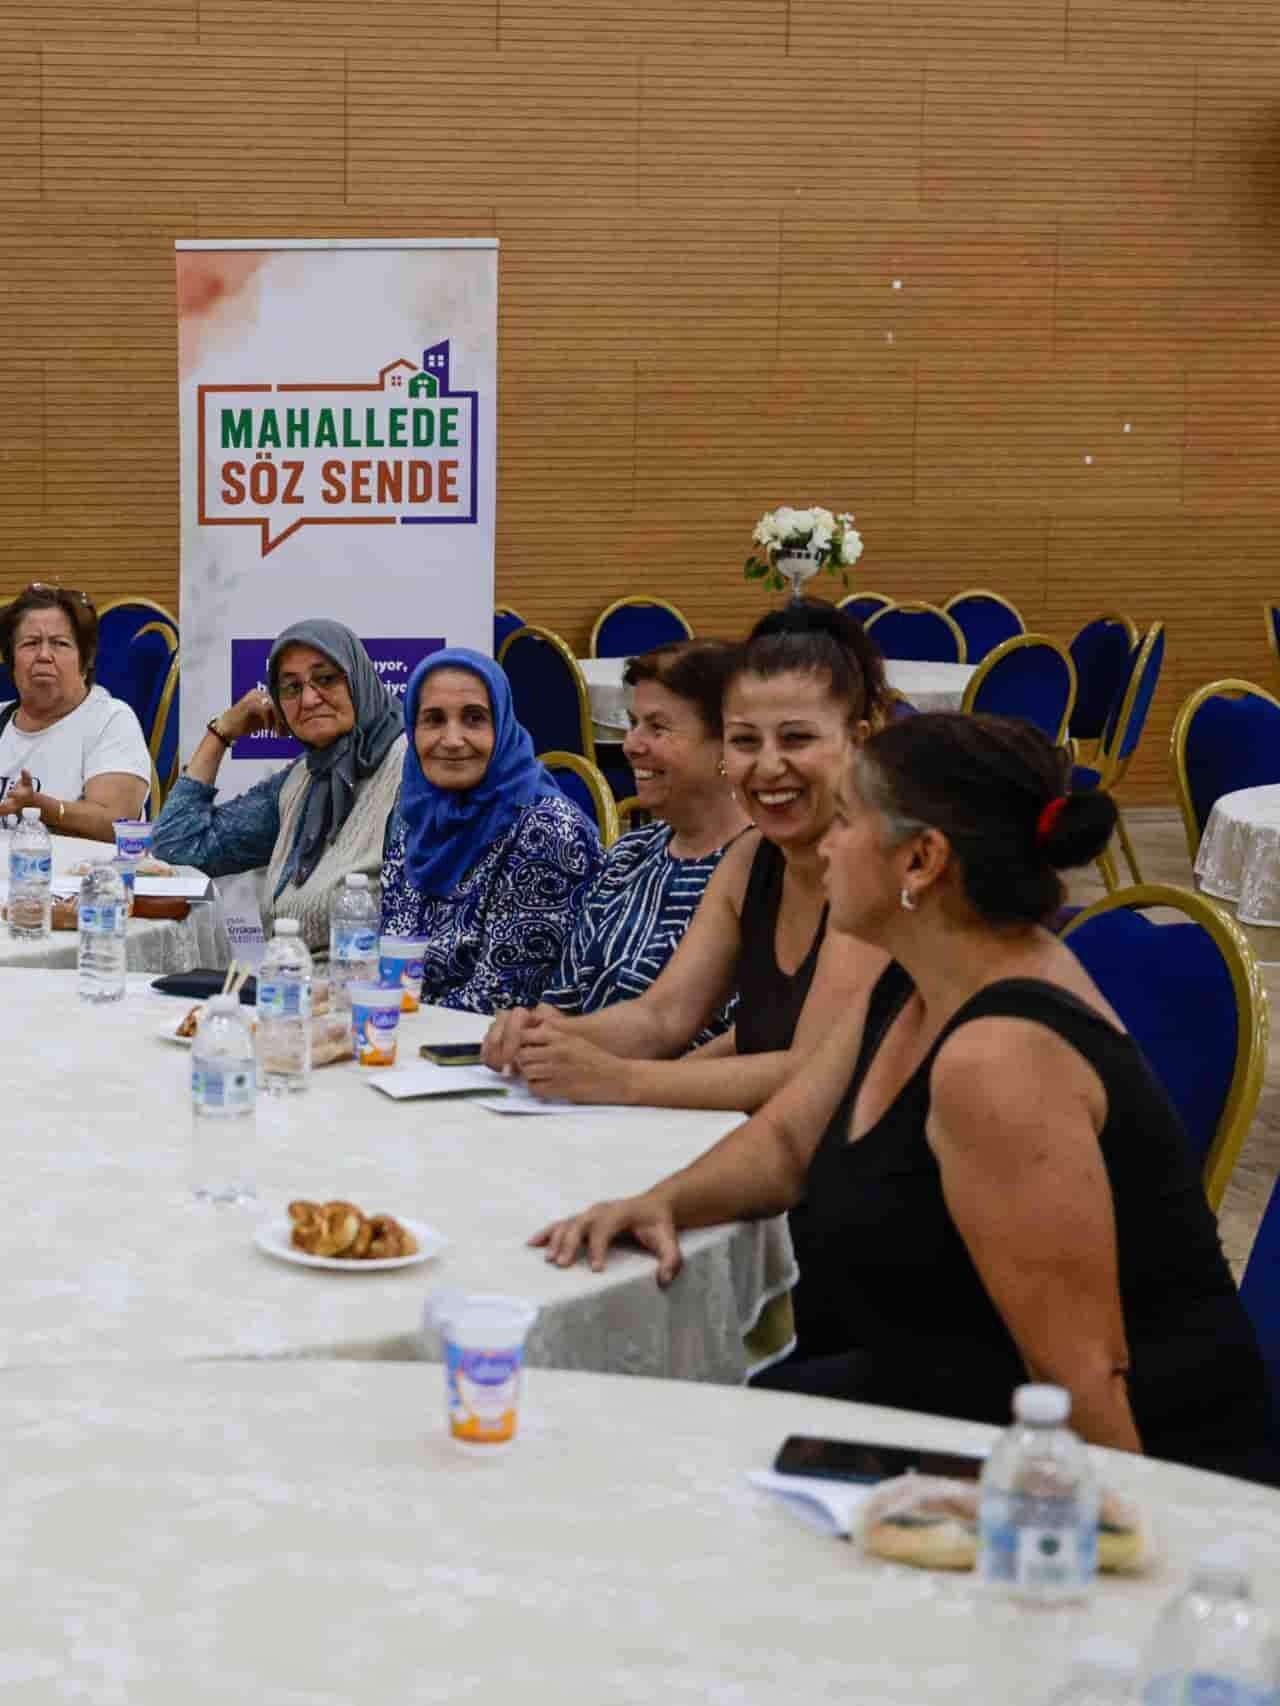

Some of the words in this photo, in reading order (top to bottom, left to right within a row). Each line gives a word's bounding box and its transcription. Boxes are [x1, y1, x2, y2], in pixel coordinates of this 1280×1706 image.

[221, 407, 459, 449] MAHALLEDE
[221, 451, 305, 505] SÖZ
[321, 459, 459, 505] SENDE
